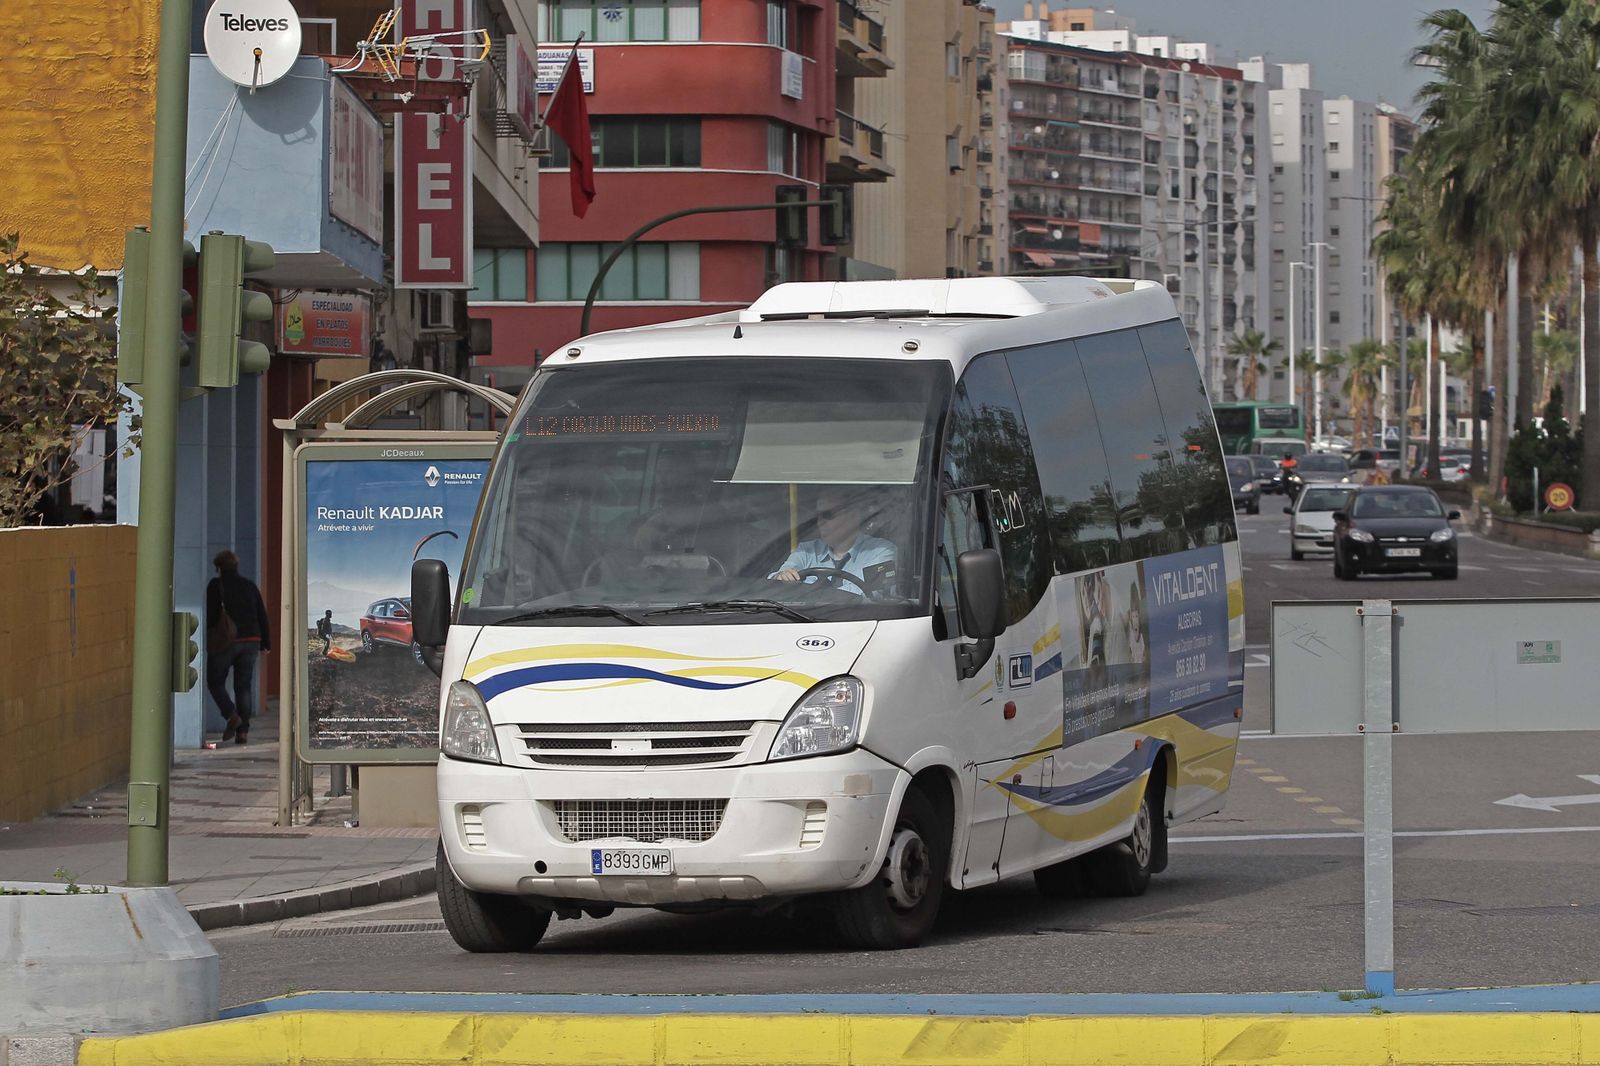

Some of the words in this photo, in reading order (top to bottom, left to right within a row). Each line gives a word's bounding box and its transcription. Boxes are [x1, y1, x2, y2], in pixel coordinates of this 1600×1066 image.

[219, 13, 289, 32] Televes
[312, 300, 353, 312] ESPECIALIDAD
[316, 319, 325, 329] EN
[327, 319, 349, 330] PLATOS
[526, 416, 558, 436] L12
[562, 415, 615, 433] CORTIJO
[380, 449, 425, 458] JCDecaux
[317, 506, 375, 520] Renault
[379, 506, 444, 519] KADJAR
[318, 523, 351, 531] Atrévete
[358, 523, 375, 531] vivir
[1152, 562, 1218, 606] VITALDENT
[1177, 609, 1202, 630] ALGECIRAS
[801, 639, 829, 647] 364
